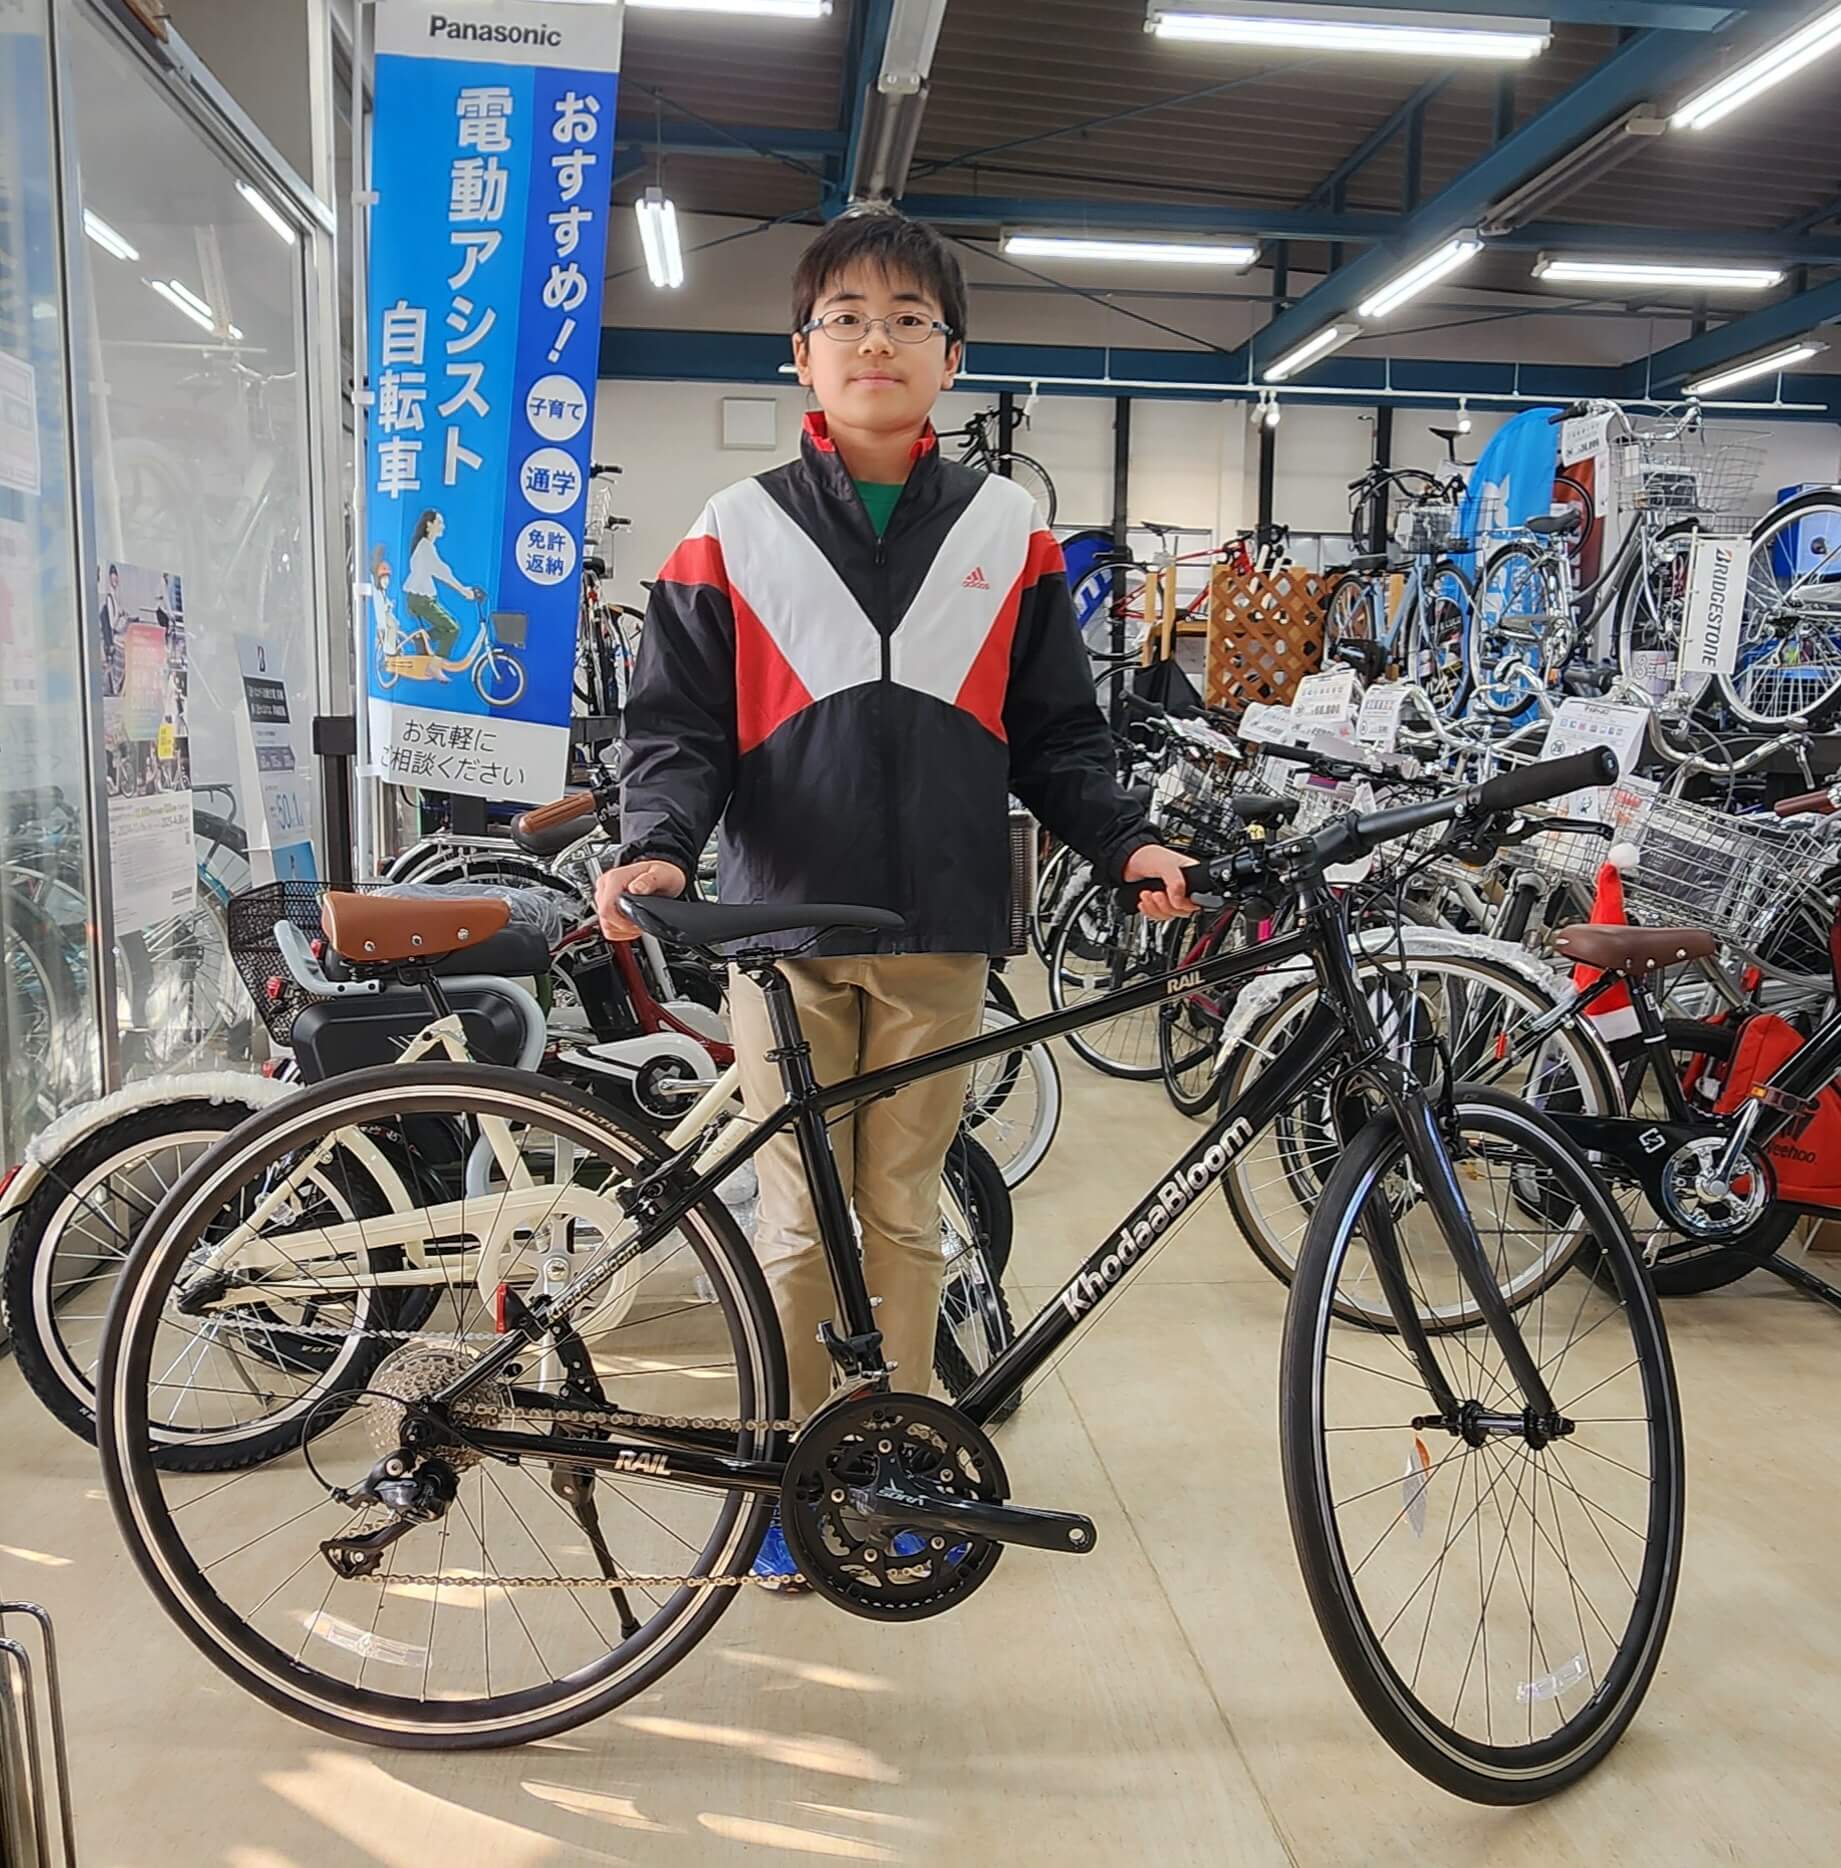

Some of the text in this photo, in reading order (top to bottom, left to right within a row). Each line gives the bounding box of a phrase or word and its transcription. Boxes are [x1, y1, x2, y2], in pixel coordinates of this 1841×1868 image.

[429, 15, 562, 47] Panasonic
[542, 91, 600, 364] おすすめ！
[438, 86, 513, 486] 電動アシスト
[377, 300, 428, 499] 自転車
[529, 397, 584, 421] 子育て
[525, 466, 576, 496] 通学
[528, 529, 566, 552] 免許
[525, 553, 565, 577] 返納
[1702, 547, 1733, 668] BRIDGESTONE
[402, 719, 497, 752] お気軽に
[380, 745, 525, 786] ご相談ください
[1167, 971, 1206, 994] RAIL
[1062, 1116, 1254, 1322] KhodaaBloom
[614, 1450, 672, 1475] RAIL
